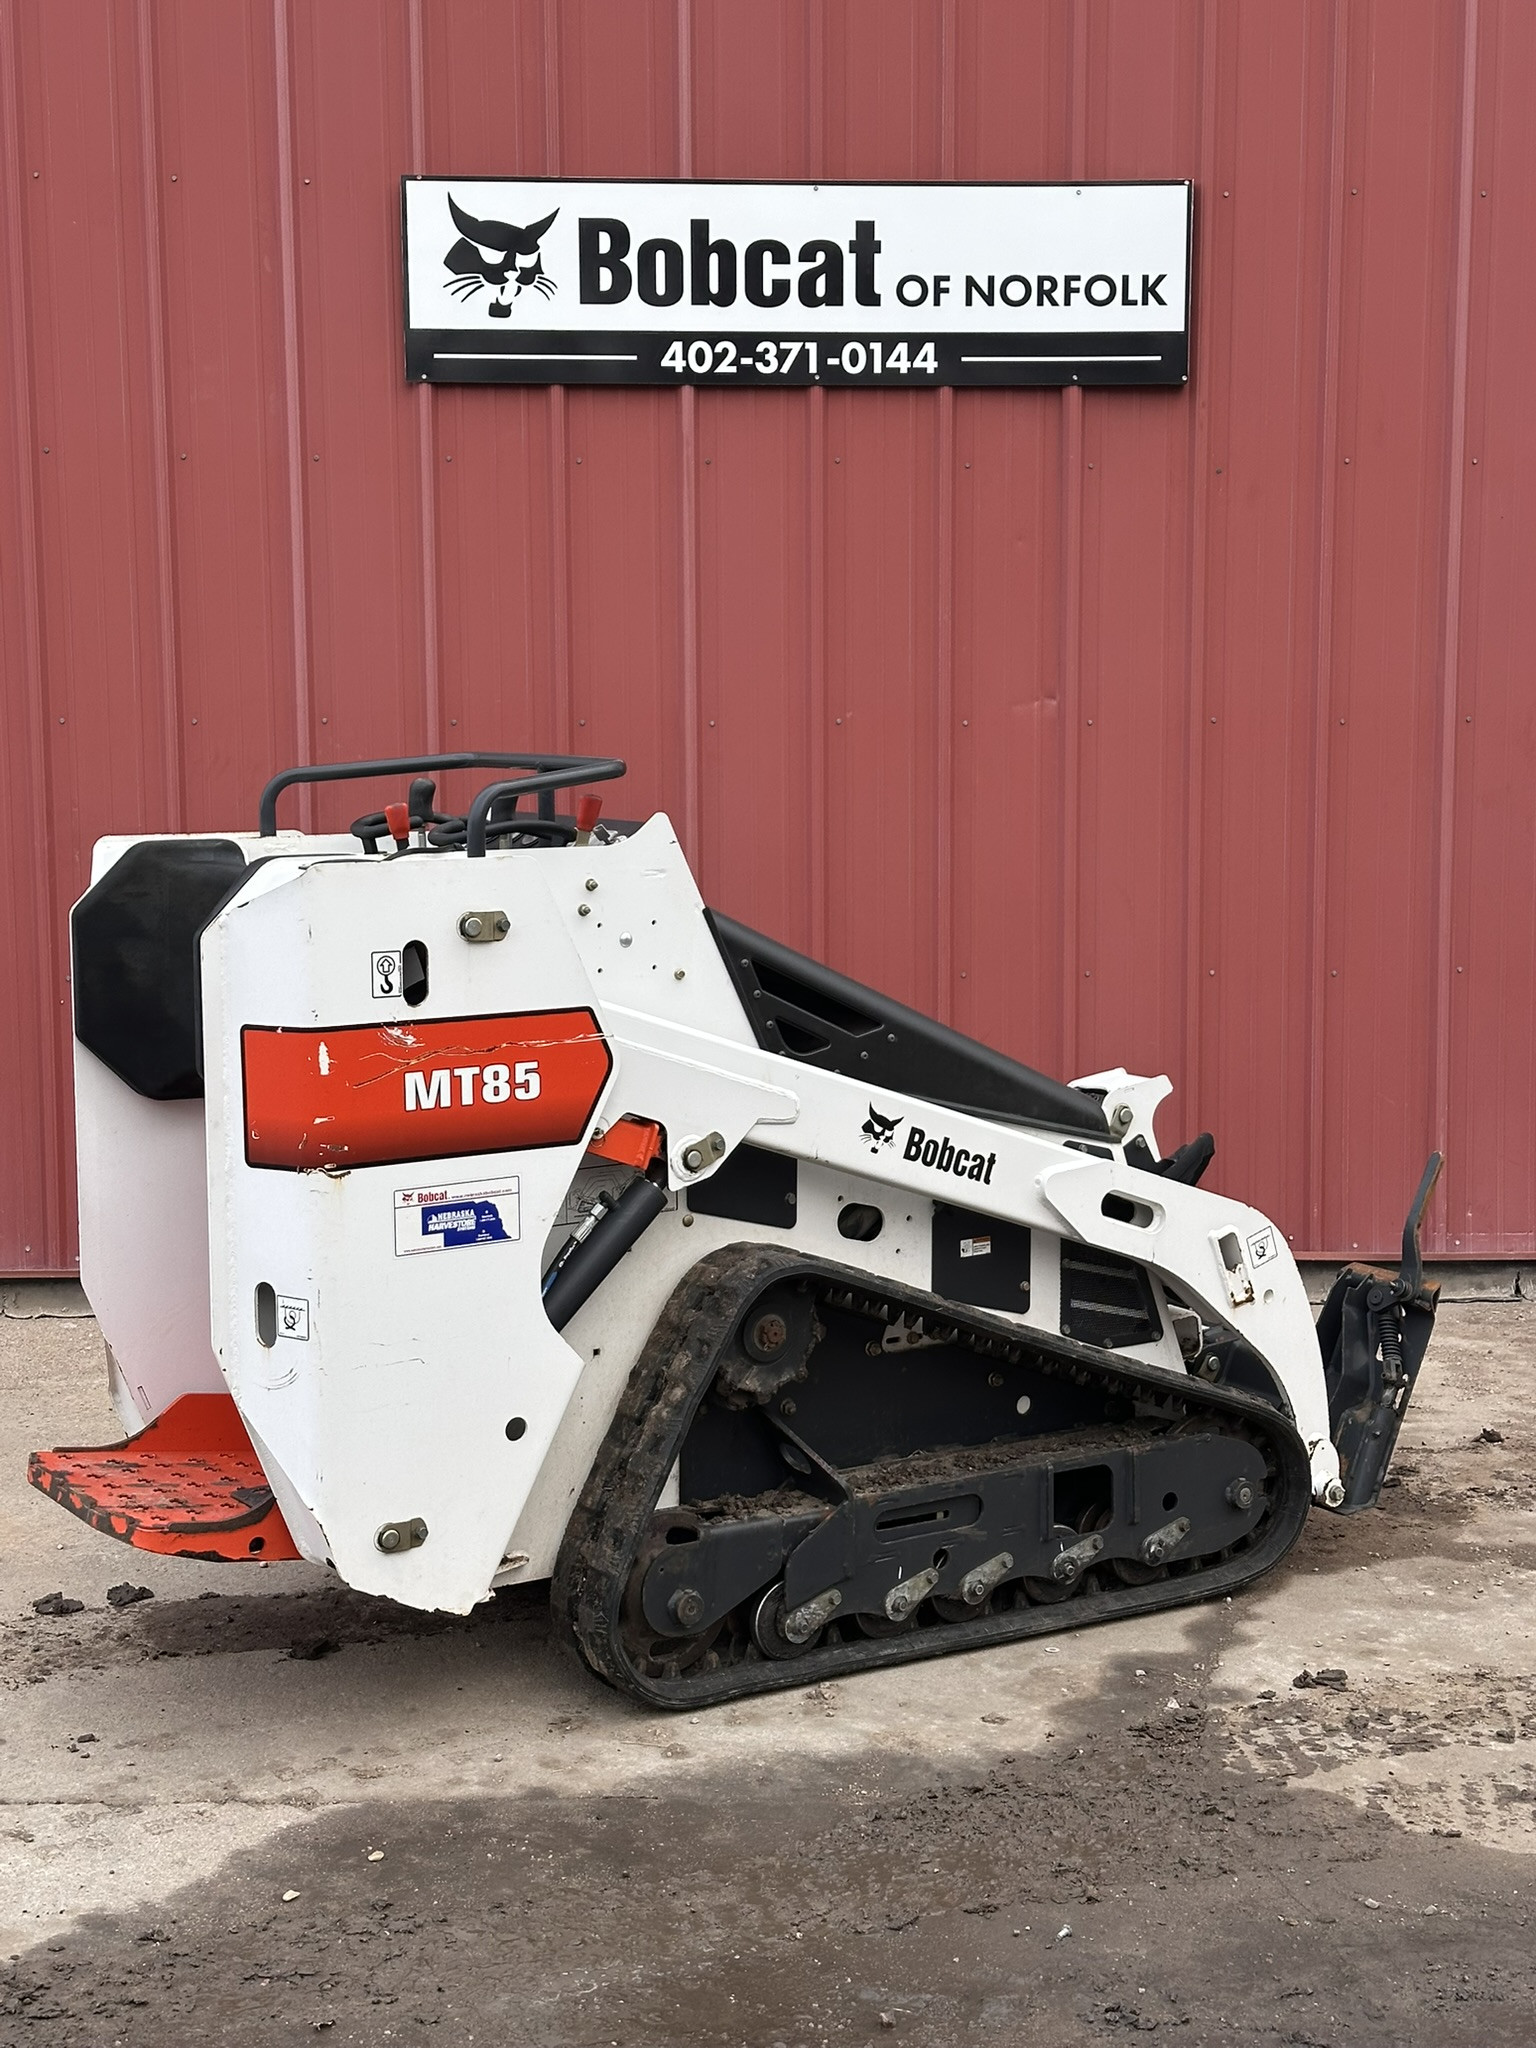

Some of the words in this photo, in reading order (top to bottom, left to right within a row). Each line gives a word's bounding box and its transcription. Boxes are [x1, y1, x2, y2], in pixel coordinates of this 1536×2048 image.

[578, 217, 882, 308] Bobcat
[895, 275, 951, 308] OF
[965, 274, 1168, 308] NORFOLK
[660, 340, 939, 375] 402-371-0144
[404, 1060, 542, 1112] MT85
[903, 1126, 997, 1186] Bobcat
[417, 1190, 448, 1204] Bobcat
[437, 1208, 476, 1221] NEBRASKA
